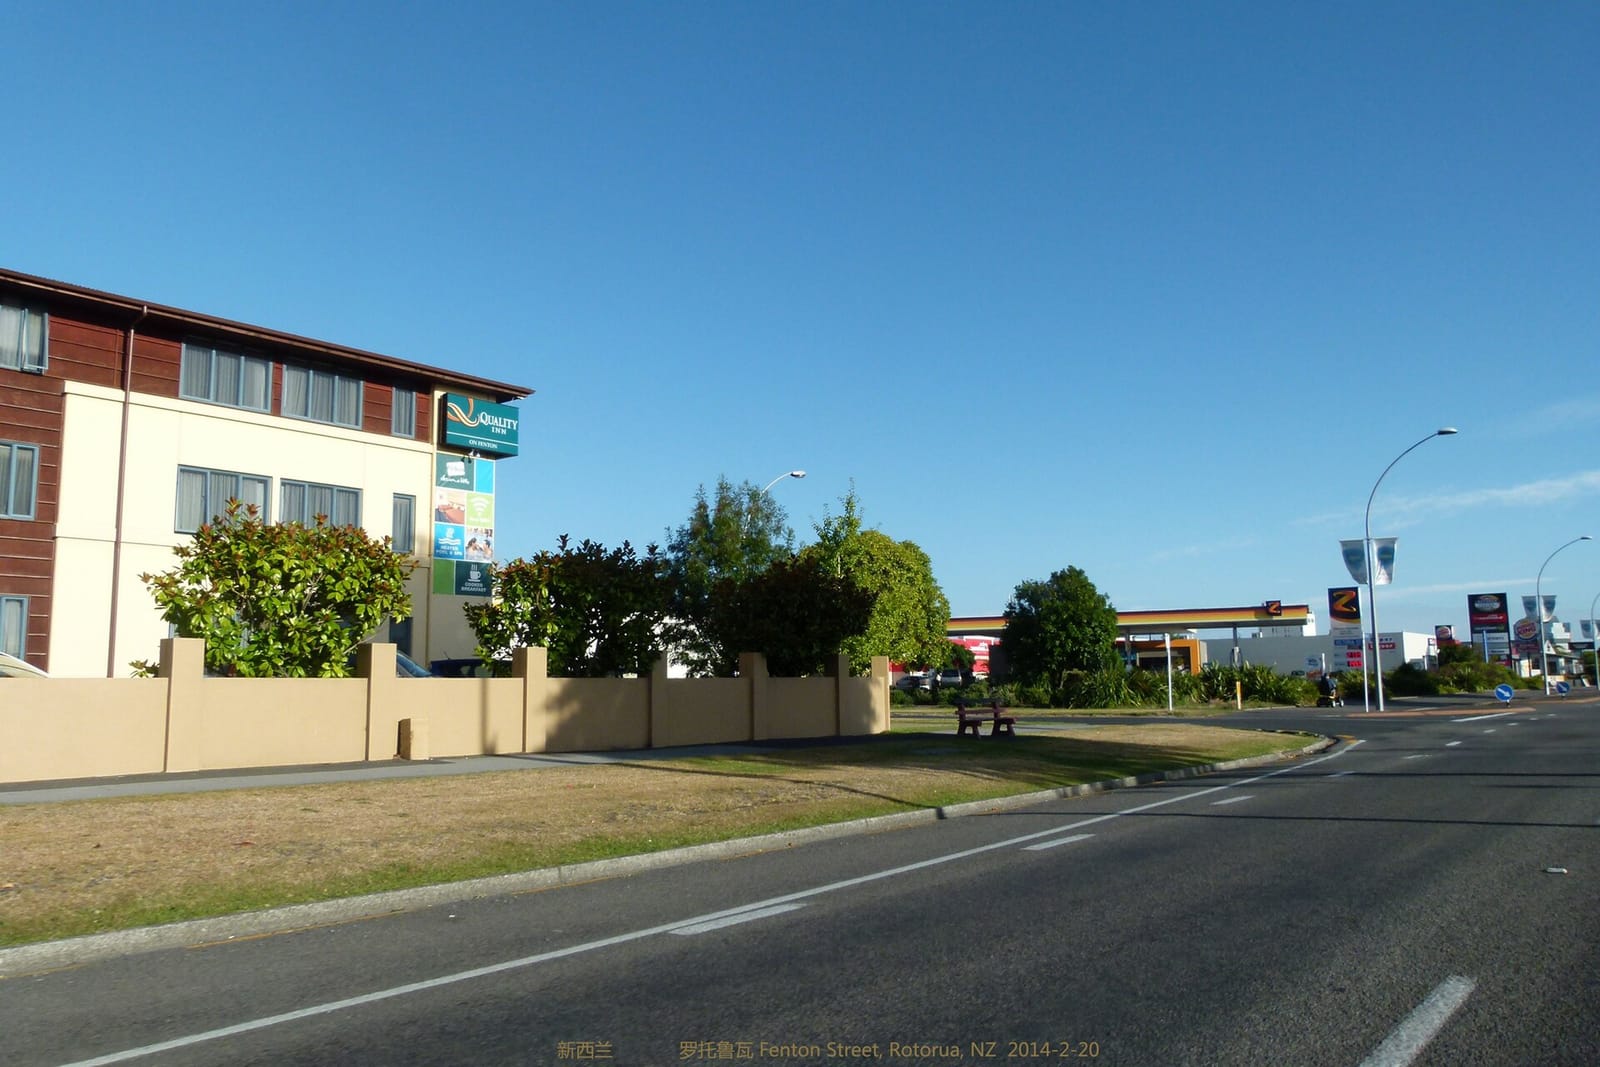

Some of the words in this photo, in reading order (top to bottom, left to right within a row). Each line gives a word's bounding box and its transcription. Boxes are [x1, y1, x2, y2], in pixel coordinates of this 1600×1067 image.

[480, 411, 518, 430] QUALITY
[491, 426, 507, 435] INN
[479, 440, 498, 449] FENTON
[1333, 590, 1357, 612] Z
[1269, 602, 1281, 614] Z
